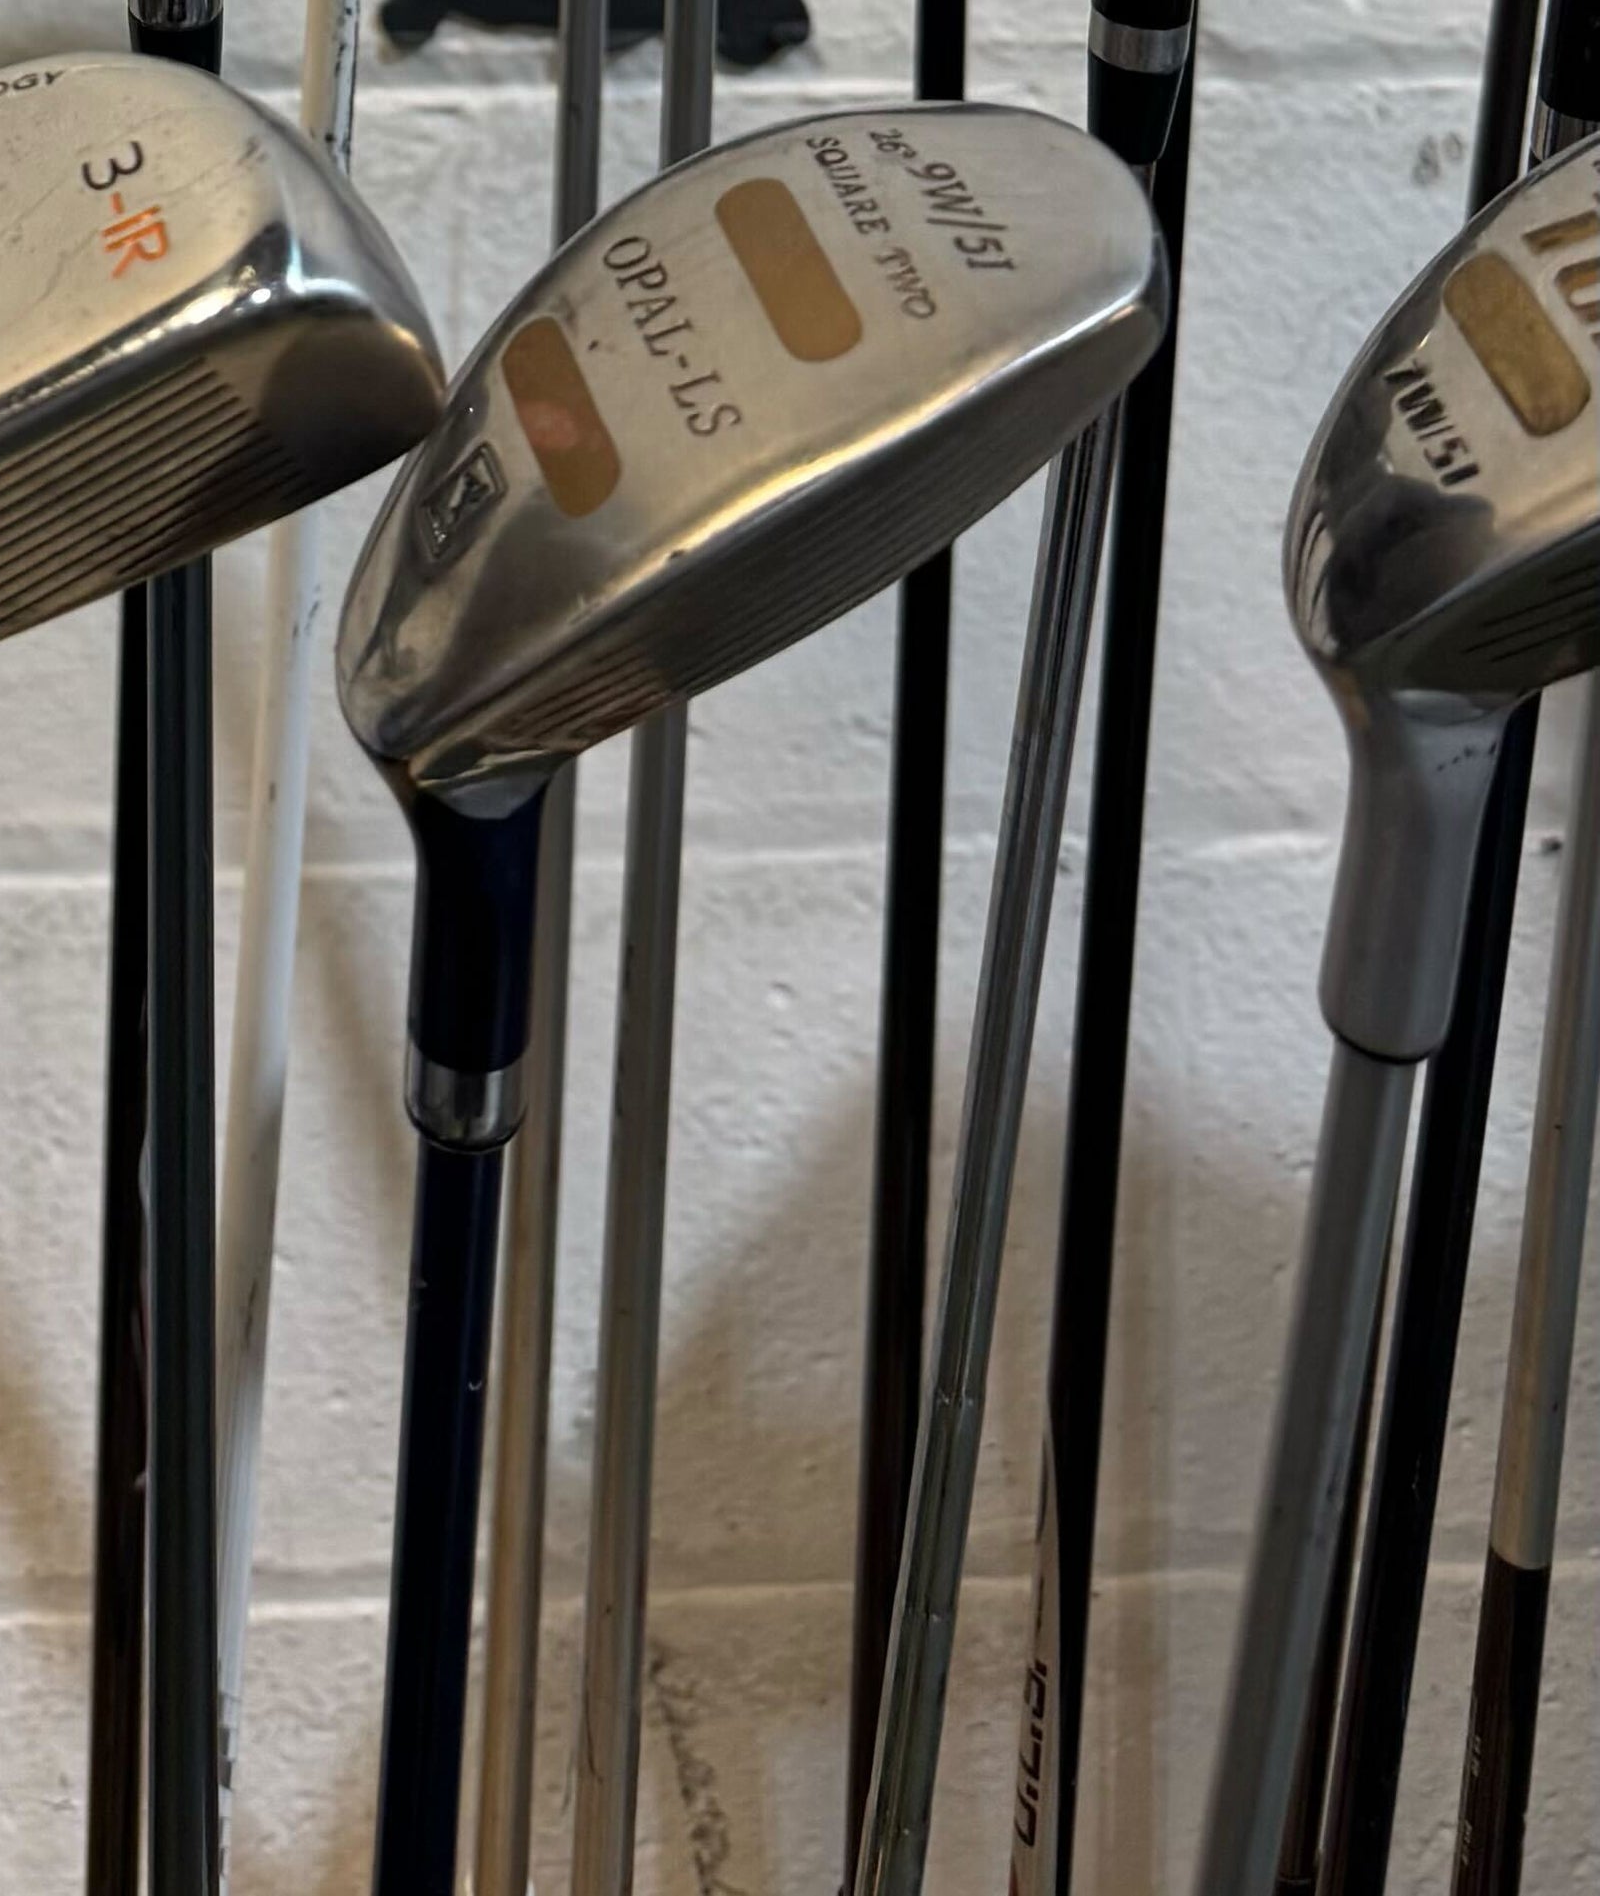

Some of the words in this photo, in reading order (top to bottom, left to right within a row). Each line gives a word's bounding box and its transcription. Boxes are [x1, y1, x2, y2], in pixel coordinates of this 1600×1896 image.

[81, 139, 171, 280] 3-IR
[805, 136, 892, 237] SQUARE
[872, 245, 937, 320] TWO
[603, 235, 743, 438] OPAL-LS
